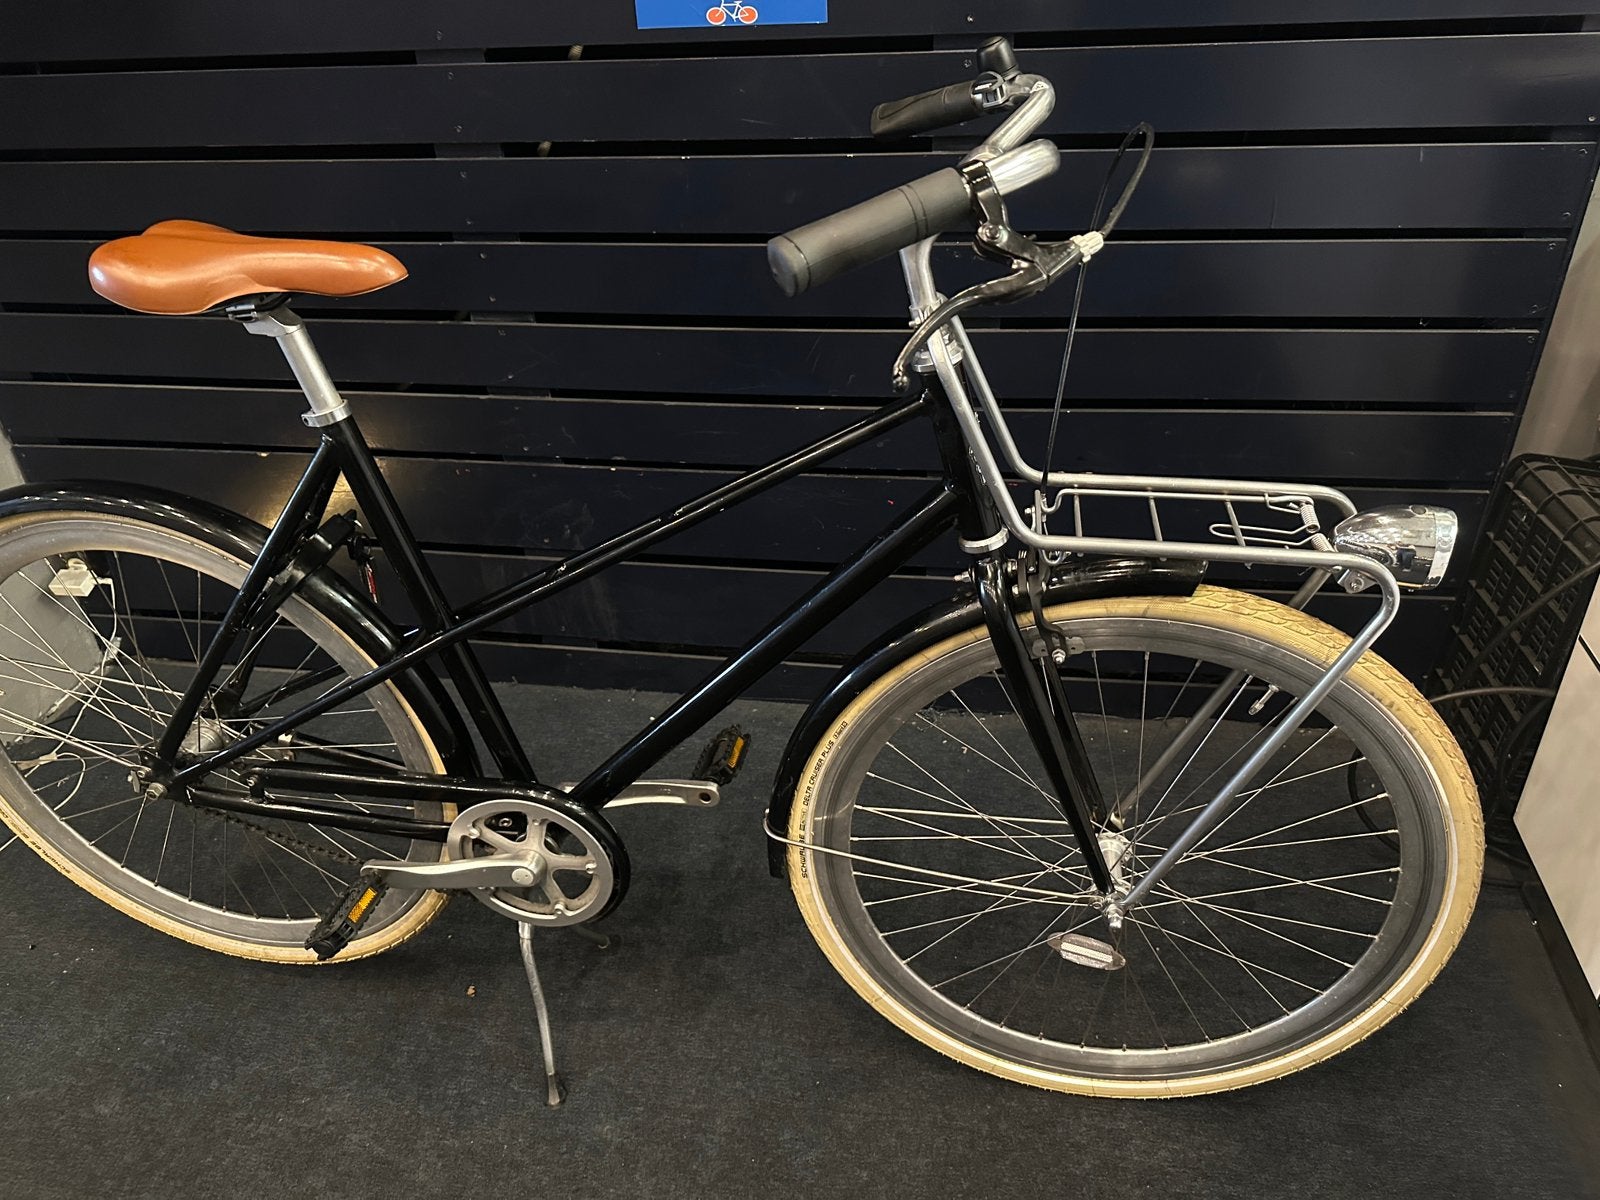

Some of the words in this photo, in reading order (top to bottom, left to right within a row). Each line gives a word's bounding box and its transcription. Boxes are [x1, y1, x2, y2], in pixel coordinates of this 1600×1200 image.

[803, 785, 812, 807] DELTA
[808, 758, 824, 785] CRUISER
[822, 740, 835, 758] PLUS
